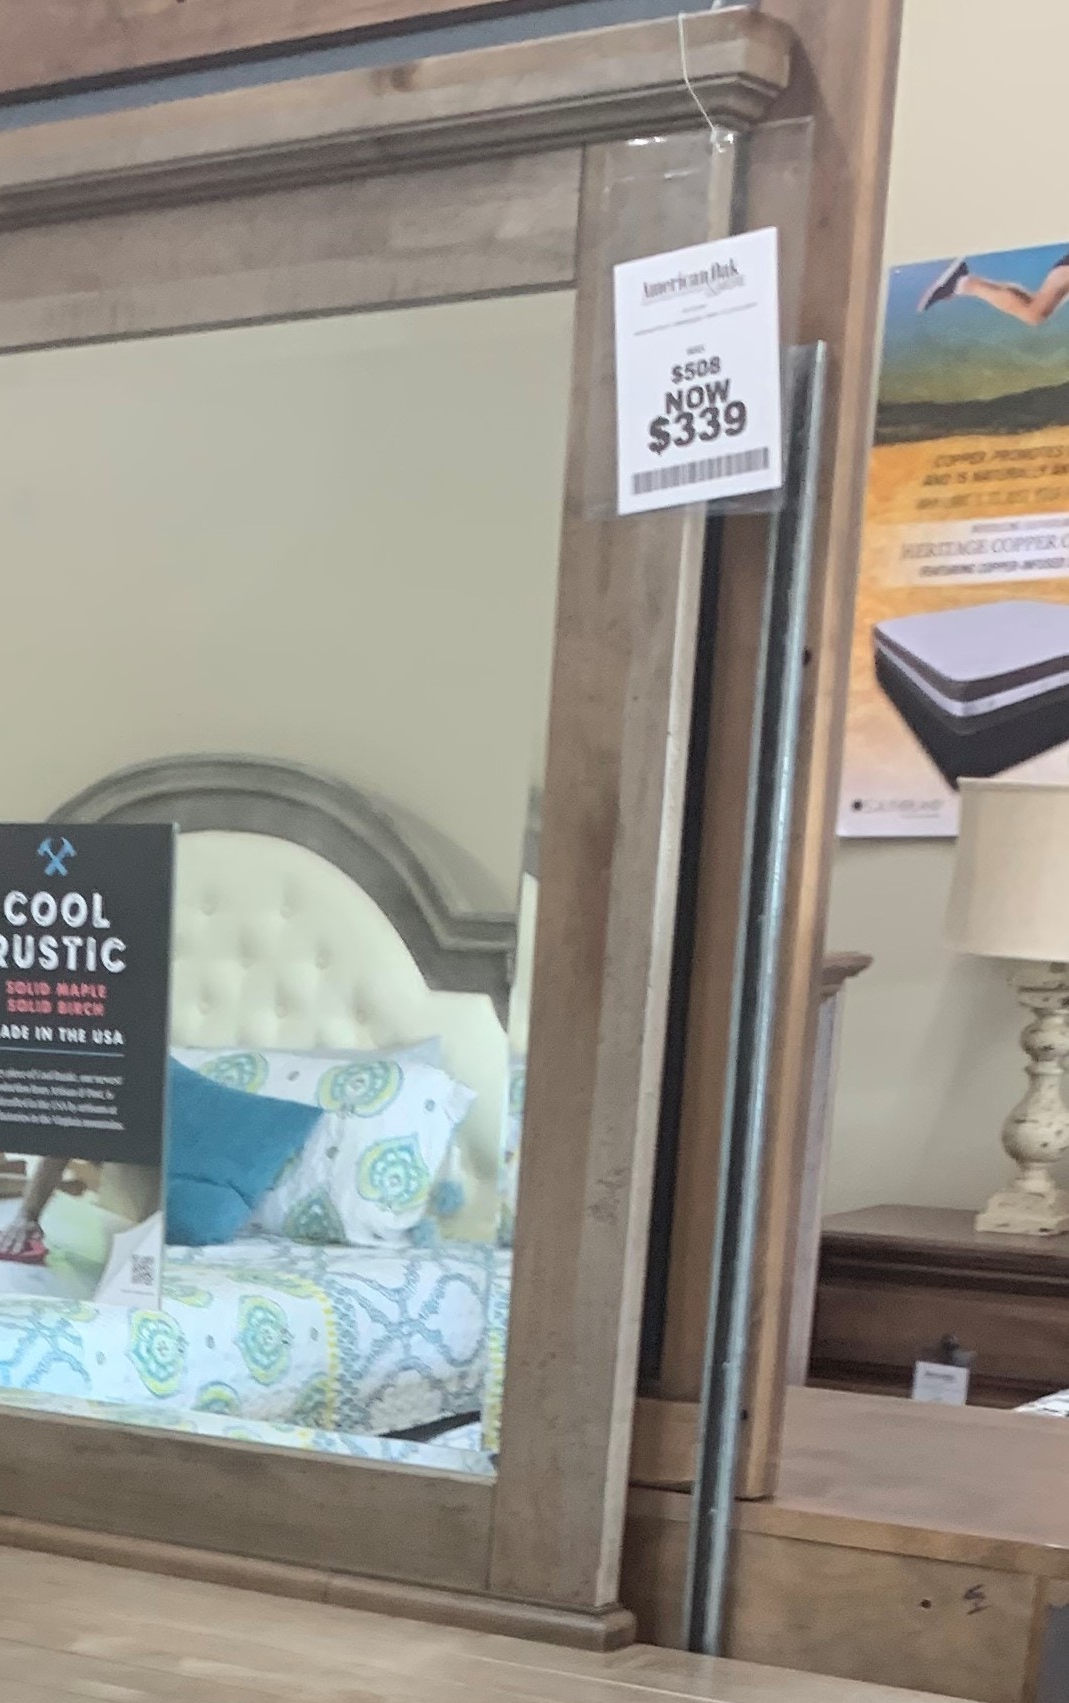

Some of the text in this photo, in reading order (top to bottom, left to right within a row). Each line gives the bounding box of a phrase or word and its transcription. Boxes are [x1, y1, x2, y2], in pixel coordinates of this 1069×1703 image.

[671, 356, 721, 385] $508
[665, 379, 730, 414] NOW
[648, 400, 748, 455] $339
[993, 534, 1058, 553] COPPER
[3, 890, 111, 929] COOL
[6, 980, 107, 999] SOLID MAPLE
[7, 998, 105, 1016] SOLID BIRCH
[34, 1025, 53, 1041] IN
[57, 1027, 87, 1043] THE
[92, 1028, 124, 1045] USA
